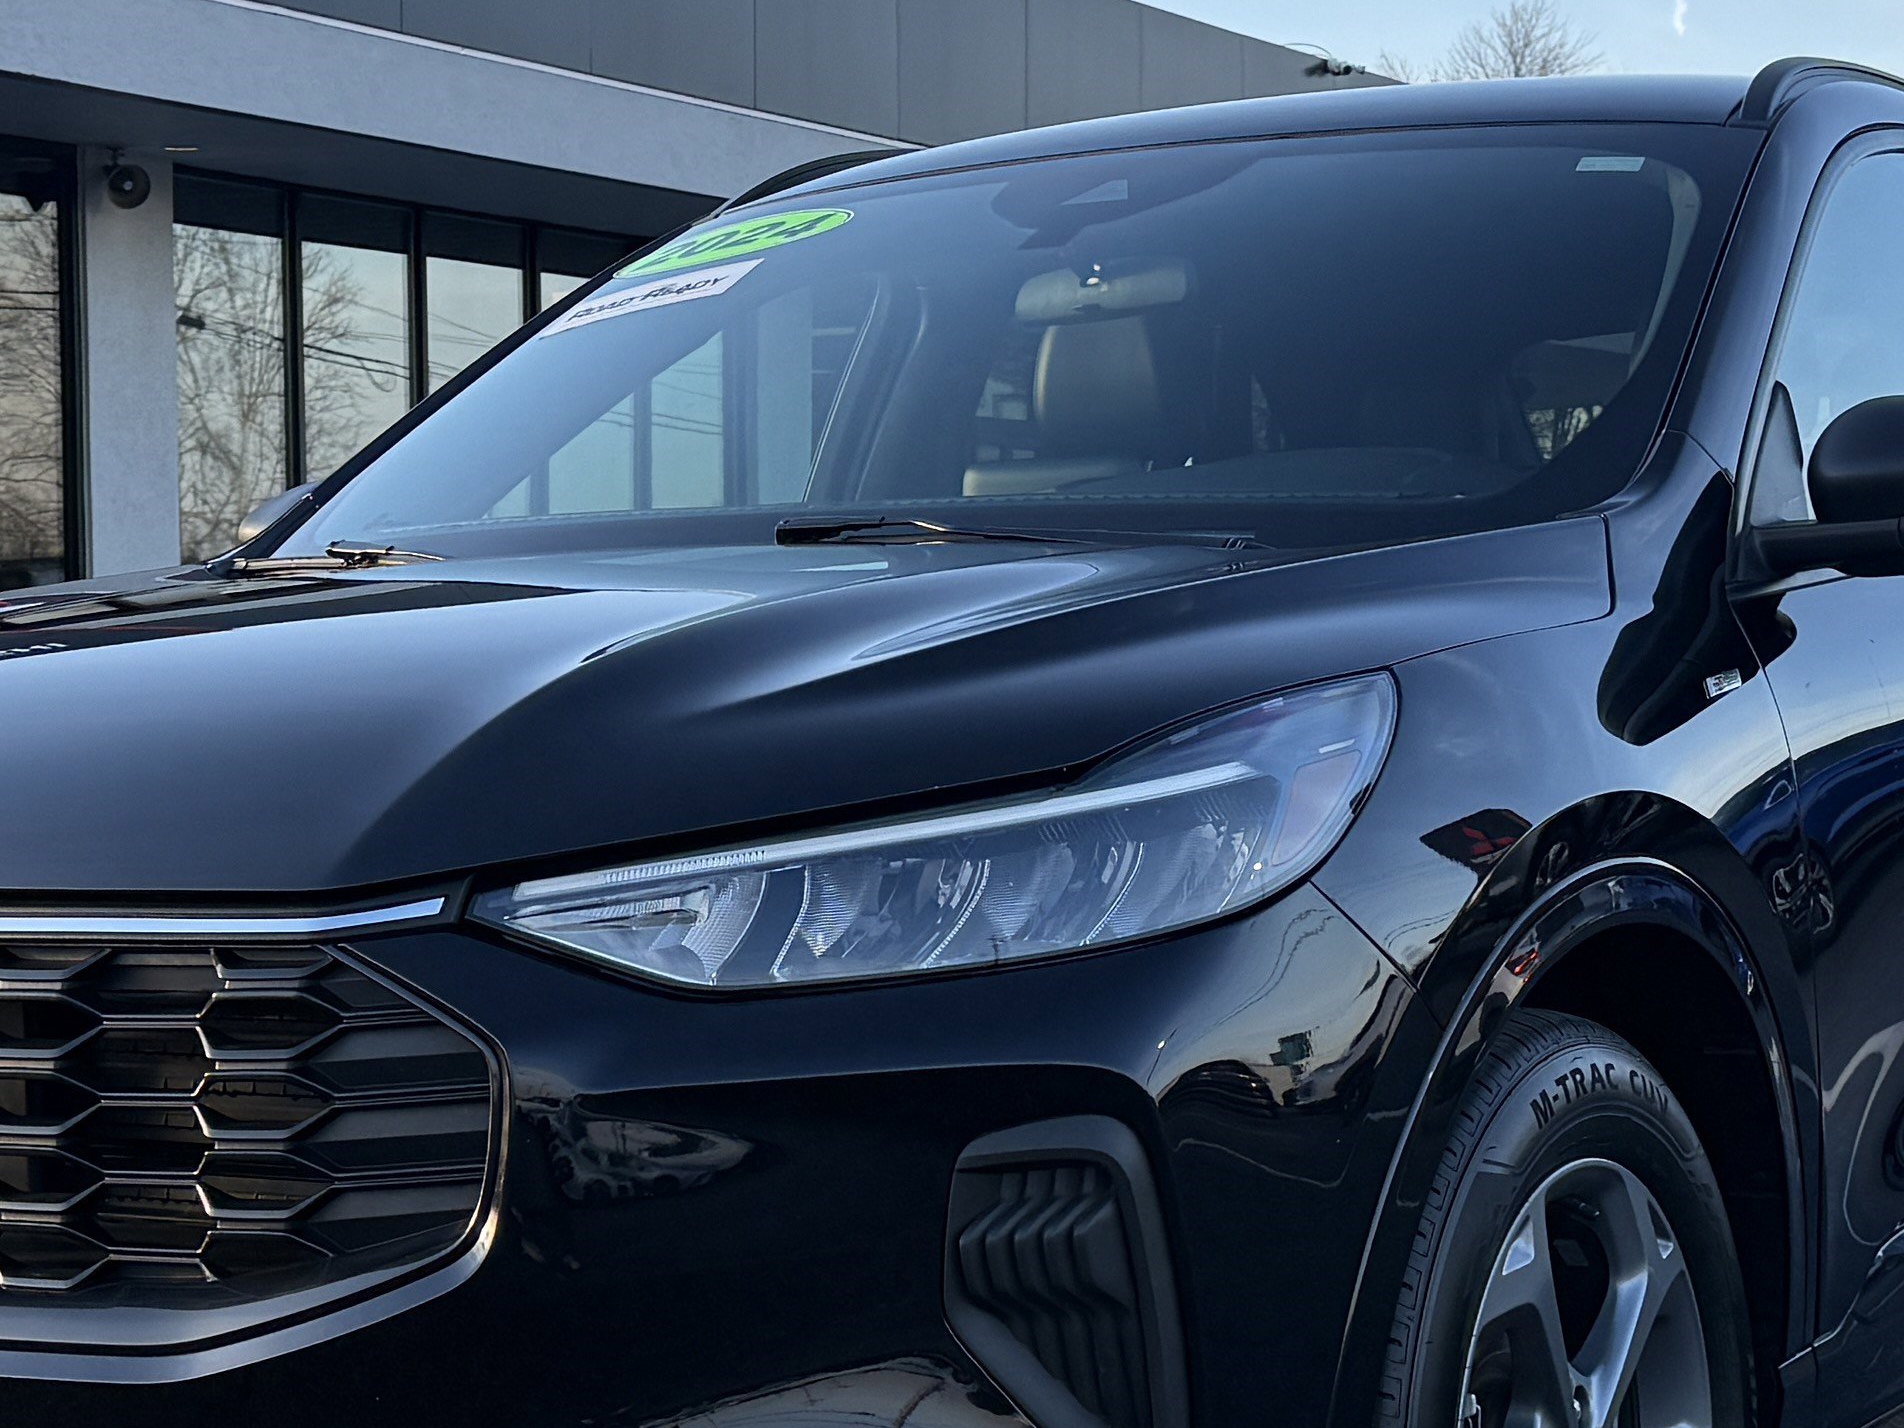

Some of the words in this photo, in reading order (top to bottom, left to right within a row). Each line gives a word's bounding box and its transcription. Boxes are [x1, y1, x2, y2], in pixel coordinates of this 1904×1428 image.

[629, 212, 836, 273] 2024
[639, 275, 730, 301] READY
[1530, 1062, 1619, 1129] M-TRAC
[1629, 1069, 1670, 1115] CUV
